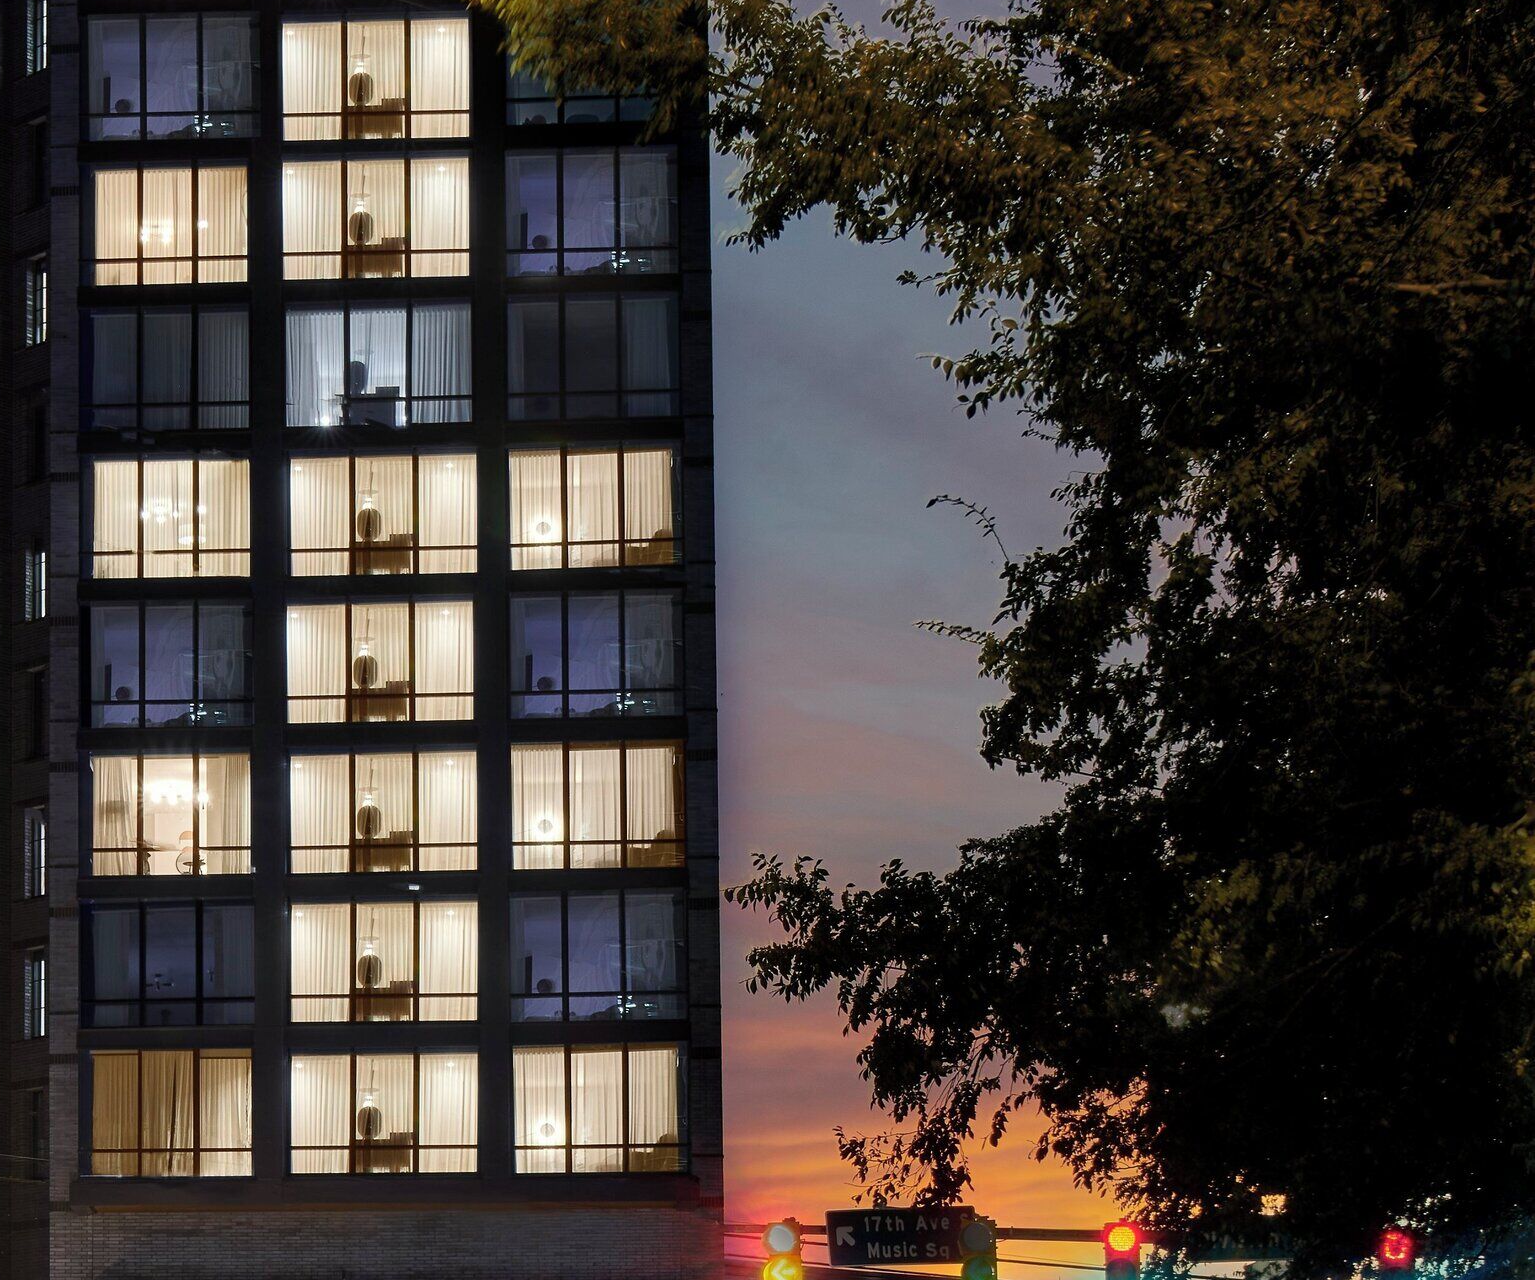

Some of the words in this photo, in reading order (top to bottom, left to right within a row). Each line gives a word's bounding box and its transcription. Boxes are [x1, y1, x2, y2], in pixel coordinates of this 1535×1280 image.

[864, 1216, 905, 1232] 17th
[916, 1215, 950, 1231] Ave
[867, 1241, 917, 1259] Music
[926, 1243, 950, 1260] Sq
